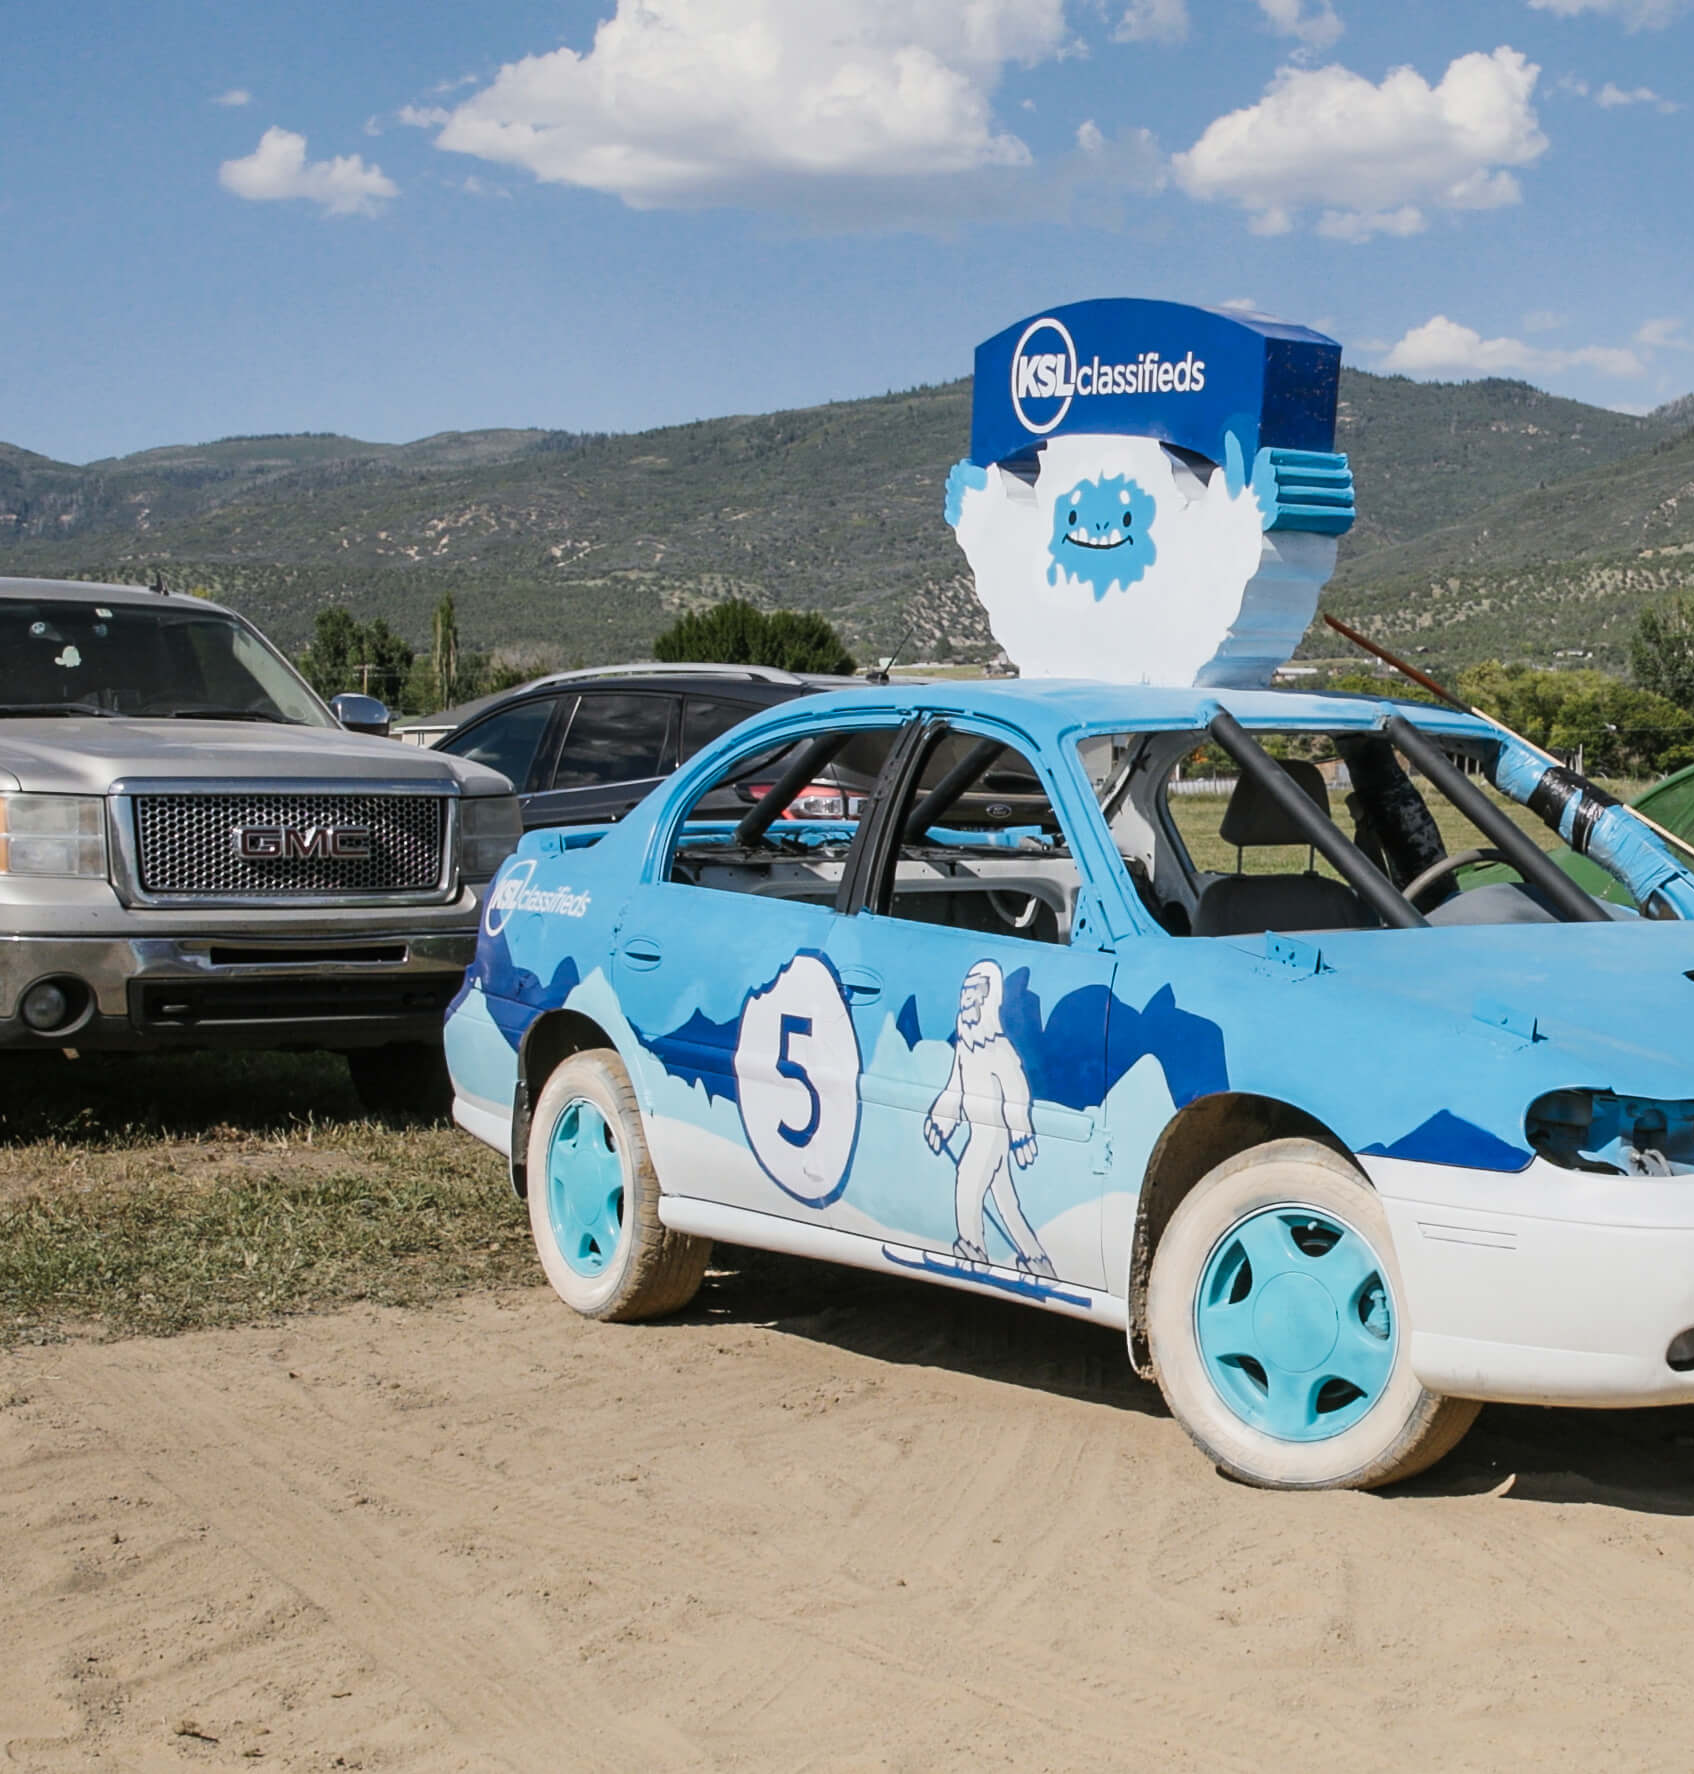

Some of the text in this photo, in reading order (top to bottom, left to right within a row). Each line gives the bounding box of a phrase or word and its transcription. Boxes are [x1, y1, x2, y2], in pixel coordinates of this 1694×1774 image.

[1017, 351, 1206, 399] KSL classifieds
[239, 826, 370, 859] GMC
[518, 884, 592, 919] classifieds
[775, 1013, 822, 1149] 5
